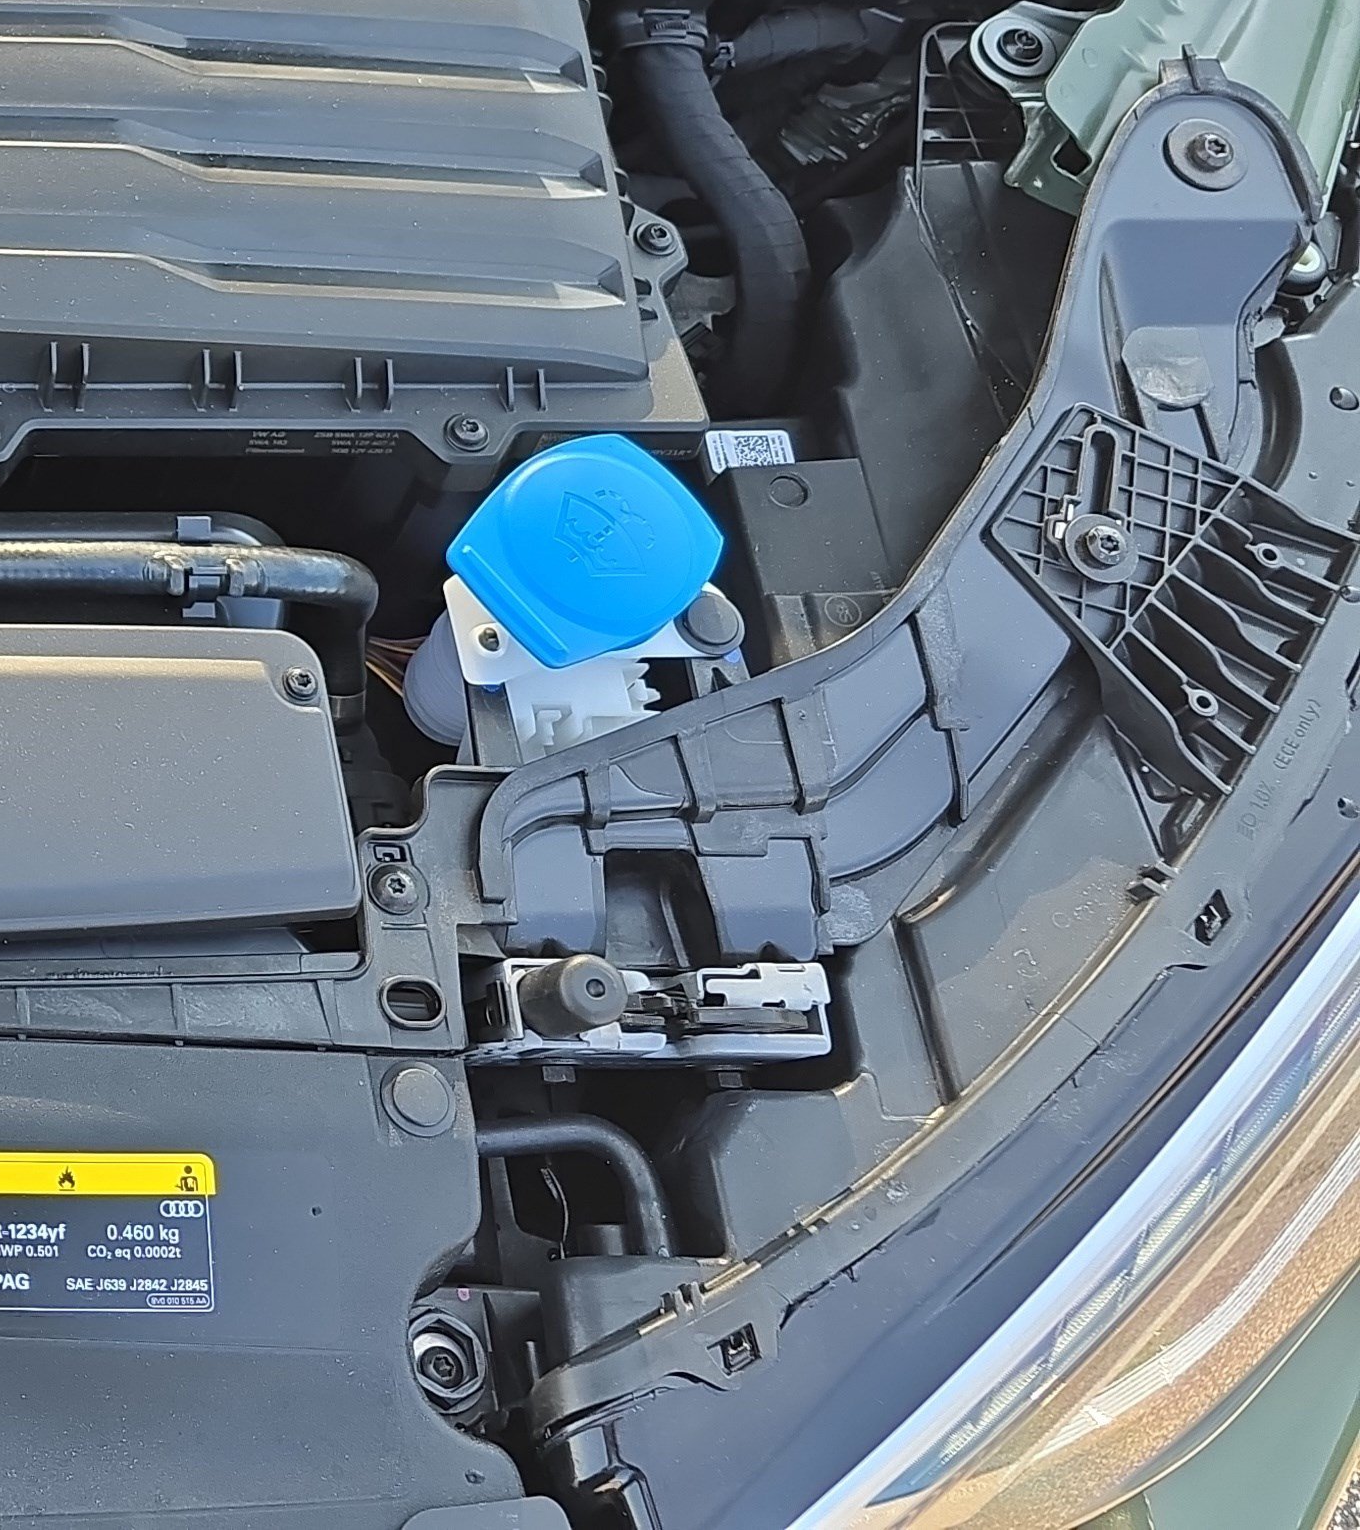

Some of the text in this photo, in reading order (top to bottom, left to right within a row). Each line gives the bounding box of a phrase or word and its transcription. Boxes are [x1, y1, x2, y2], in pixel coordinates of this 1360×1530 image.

[107, 1224, 154, 1241] 0.460
[159, 1224, 180, 1244] kg
[25, 1245, 59, 1257] 0.501
[115, 1247, 131, 1260] eq
[133, 1246, 182, 1259] 0.0002t
[66, 1278, 93, 1291] SAE
[96, 1279, 127, 1291] J639
[130, 1279, 167, 1291] J2842
[170, 1279, 208, 1292] J2845
